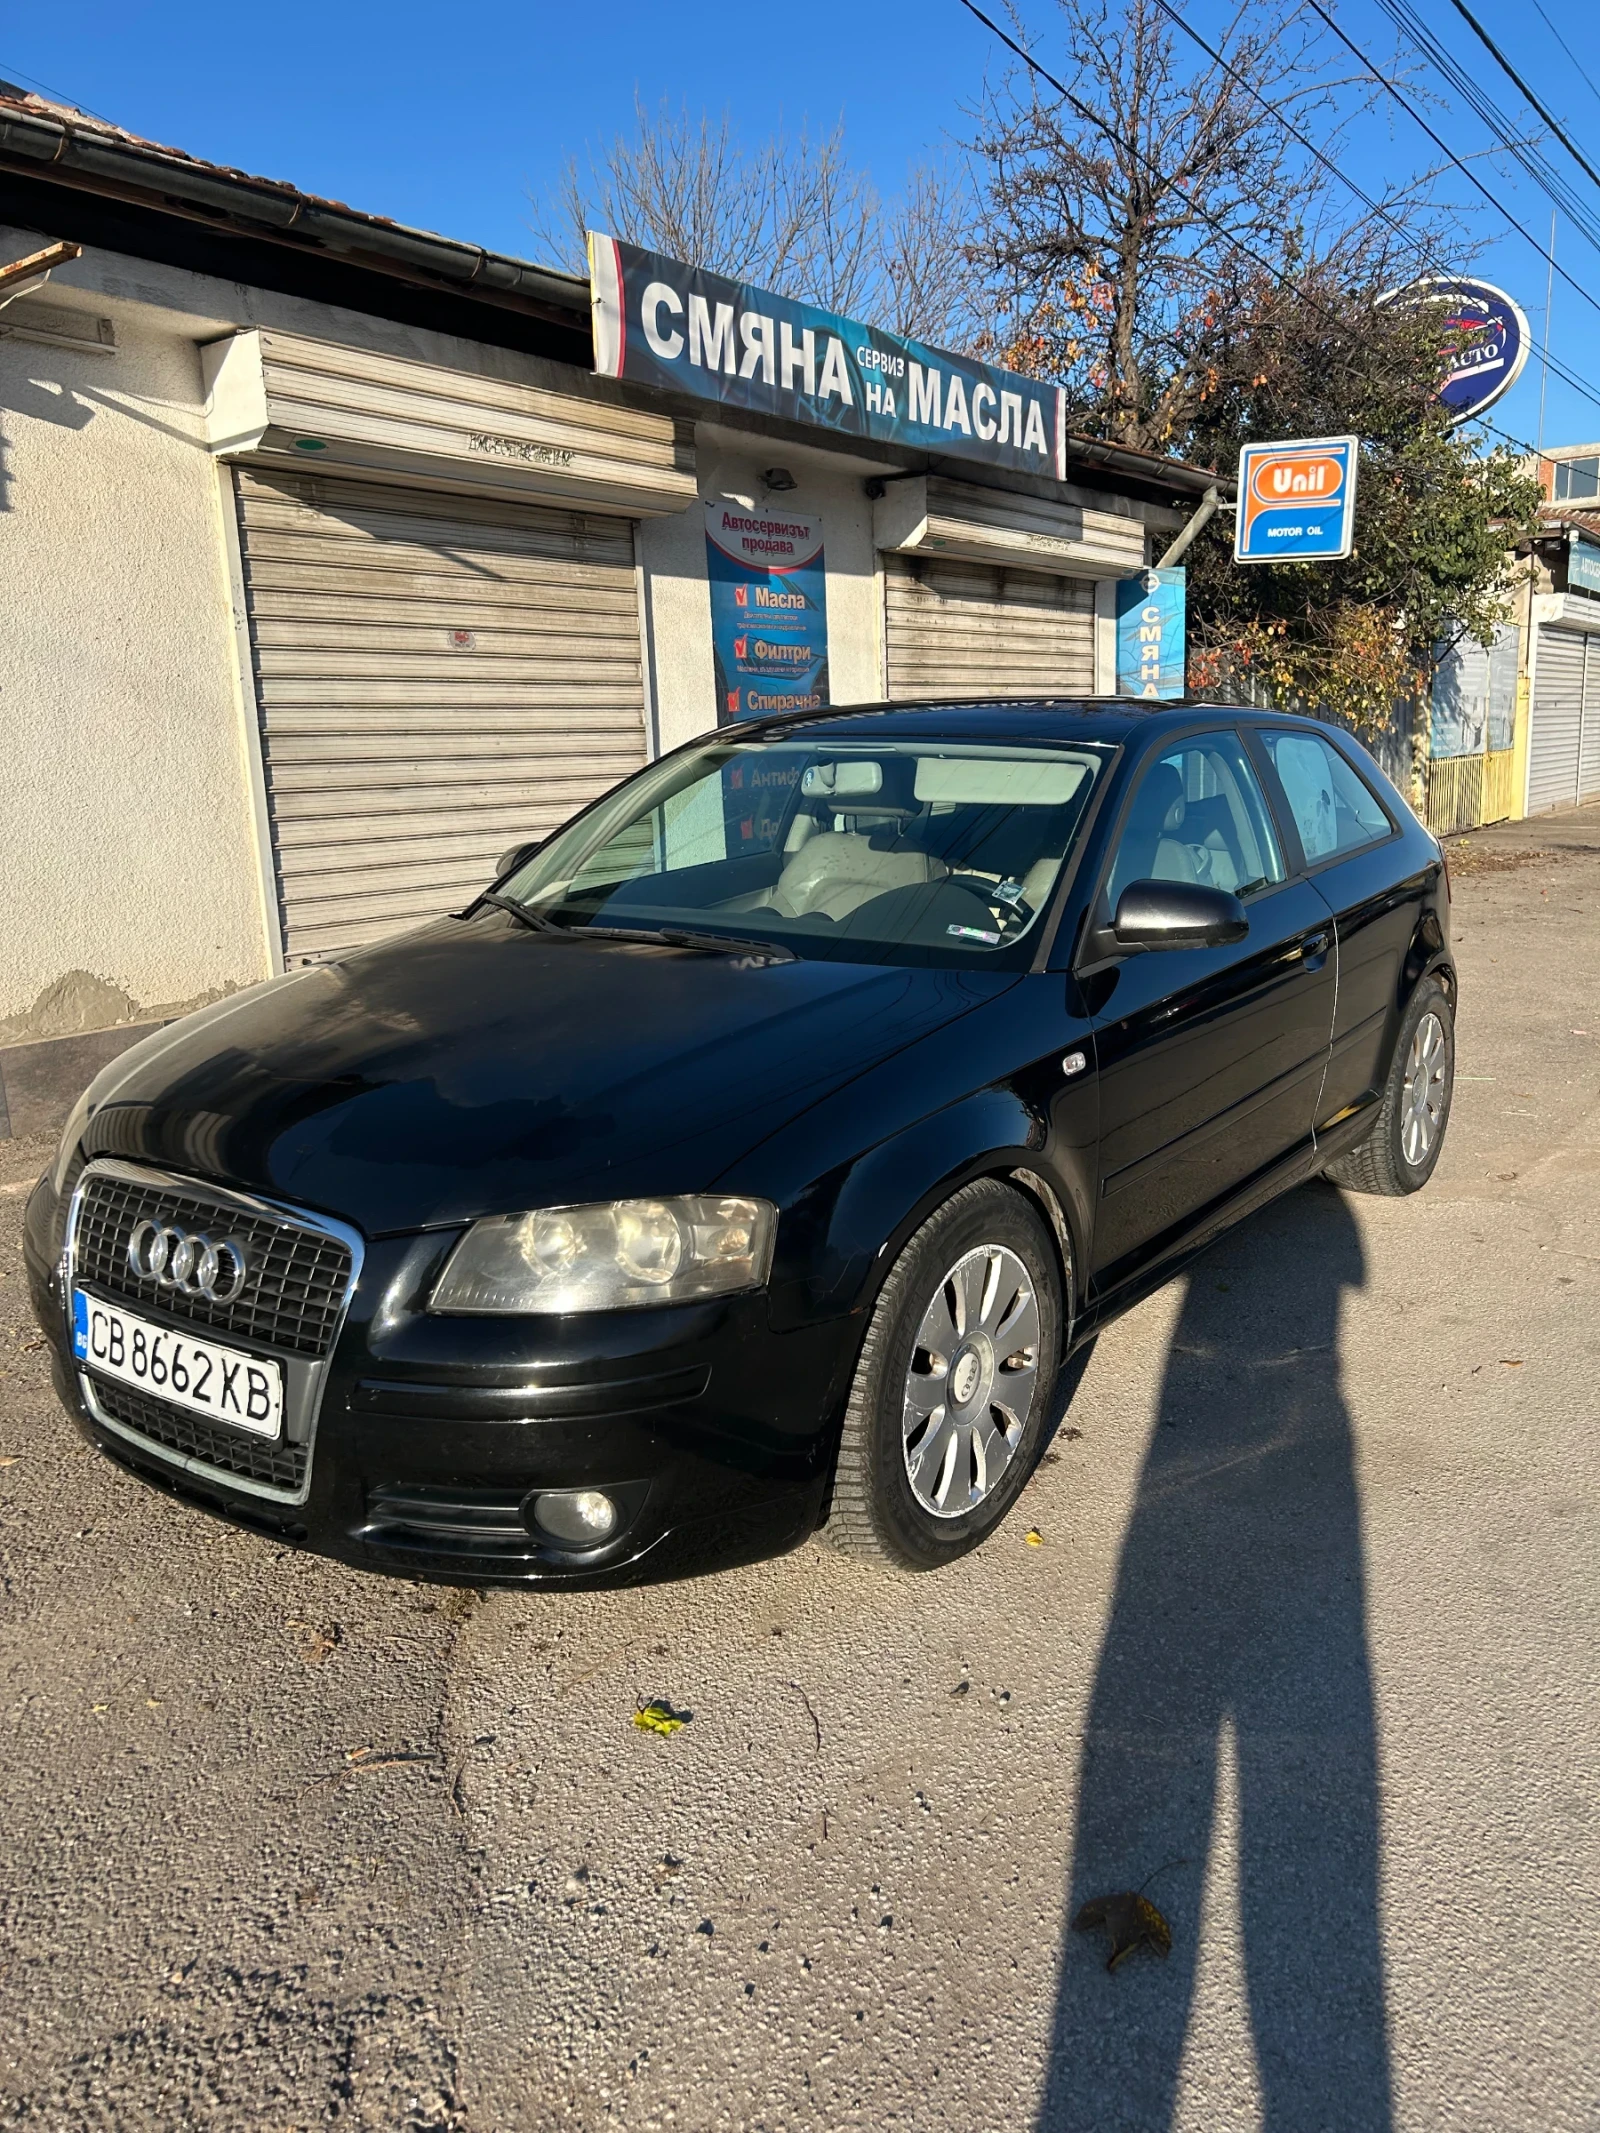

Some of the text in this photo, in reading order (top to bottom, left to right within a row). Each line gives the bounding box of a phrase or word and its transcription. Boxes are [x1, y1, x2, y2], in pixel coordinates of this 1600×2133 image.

[640, 281, 1049, 455] СМЯНА НА МАСЛА
[856, 345, 905, 378] СЕРВИЗ
[1272, 464, 1325, 493] Unil
[721, 511, 811, 540] Автосервизът
[1267, 525, 1323, 538] MOTOR OIL
[741, 535, 794, 555] продава
[755, 587, 806, 610] Масла
[754, 640, 811, 664] Филтри
[1139, 606, 1162, 697] СМЯНА
[747, 690, 821, 714] Спирачна
[76, 1331, 88, 1348] BG
